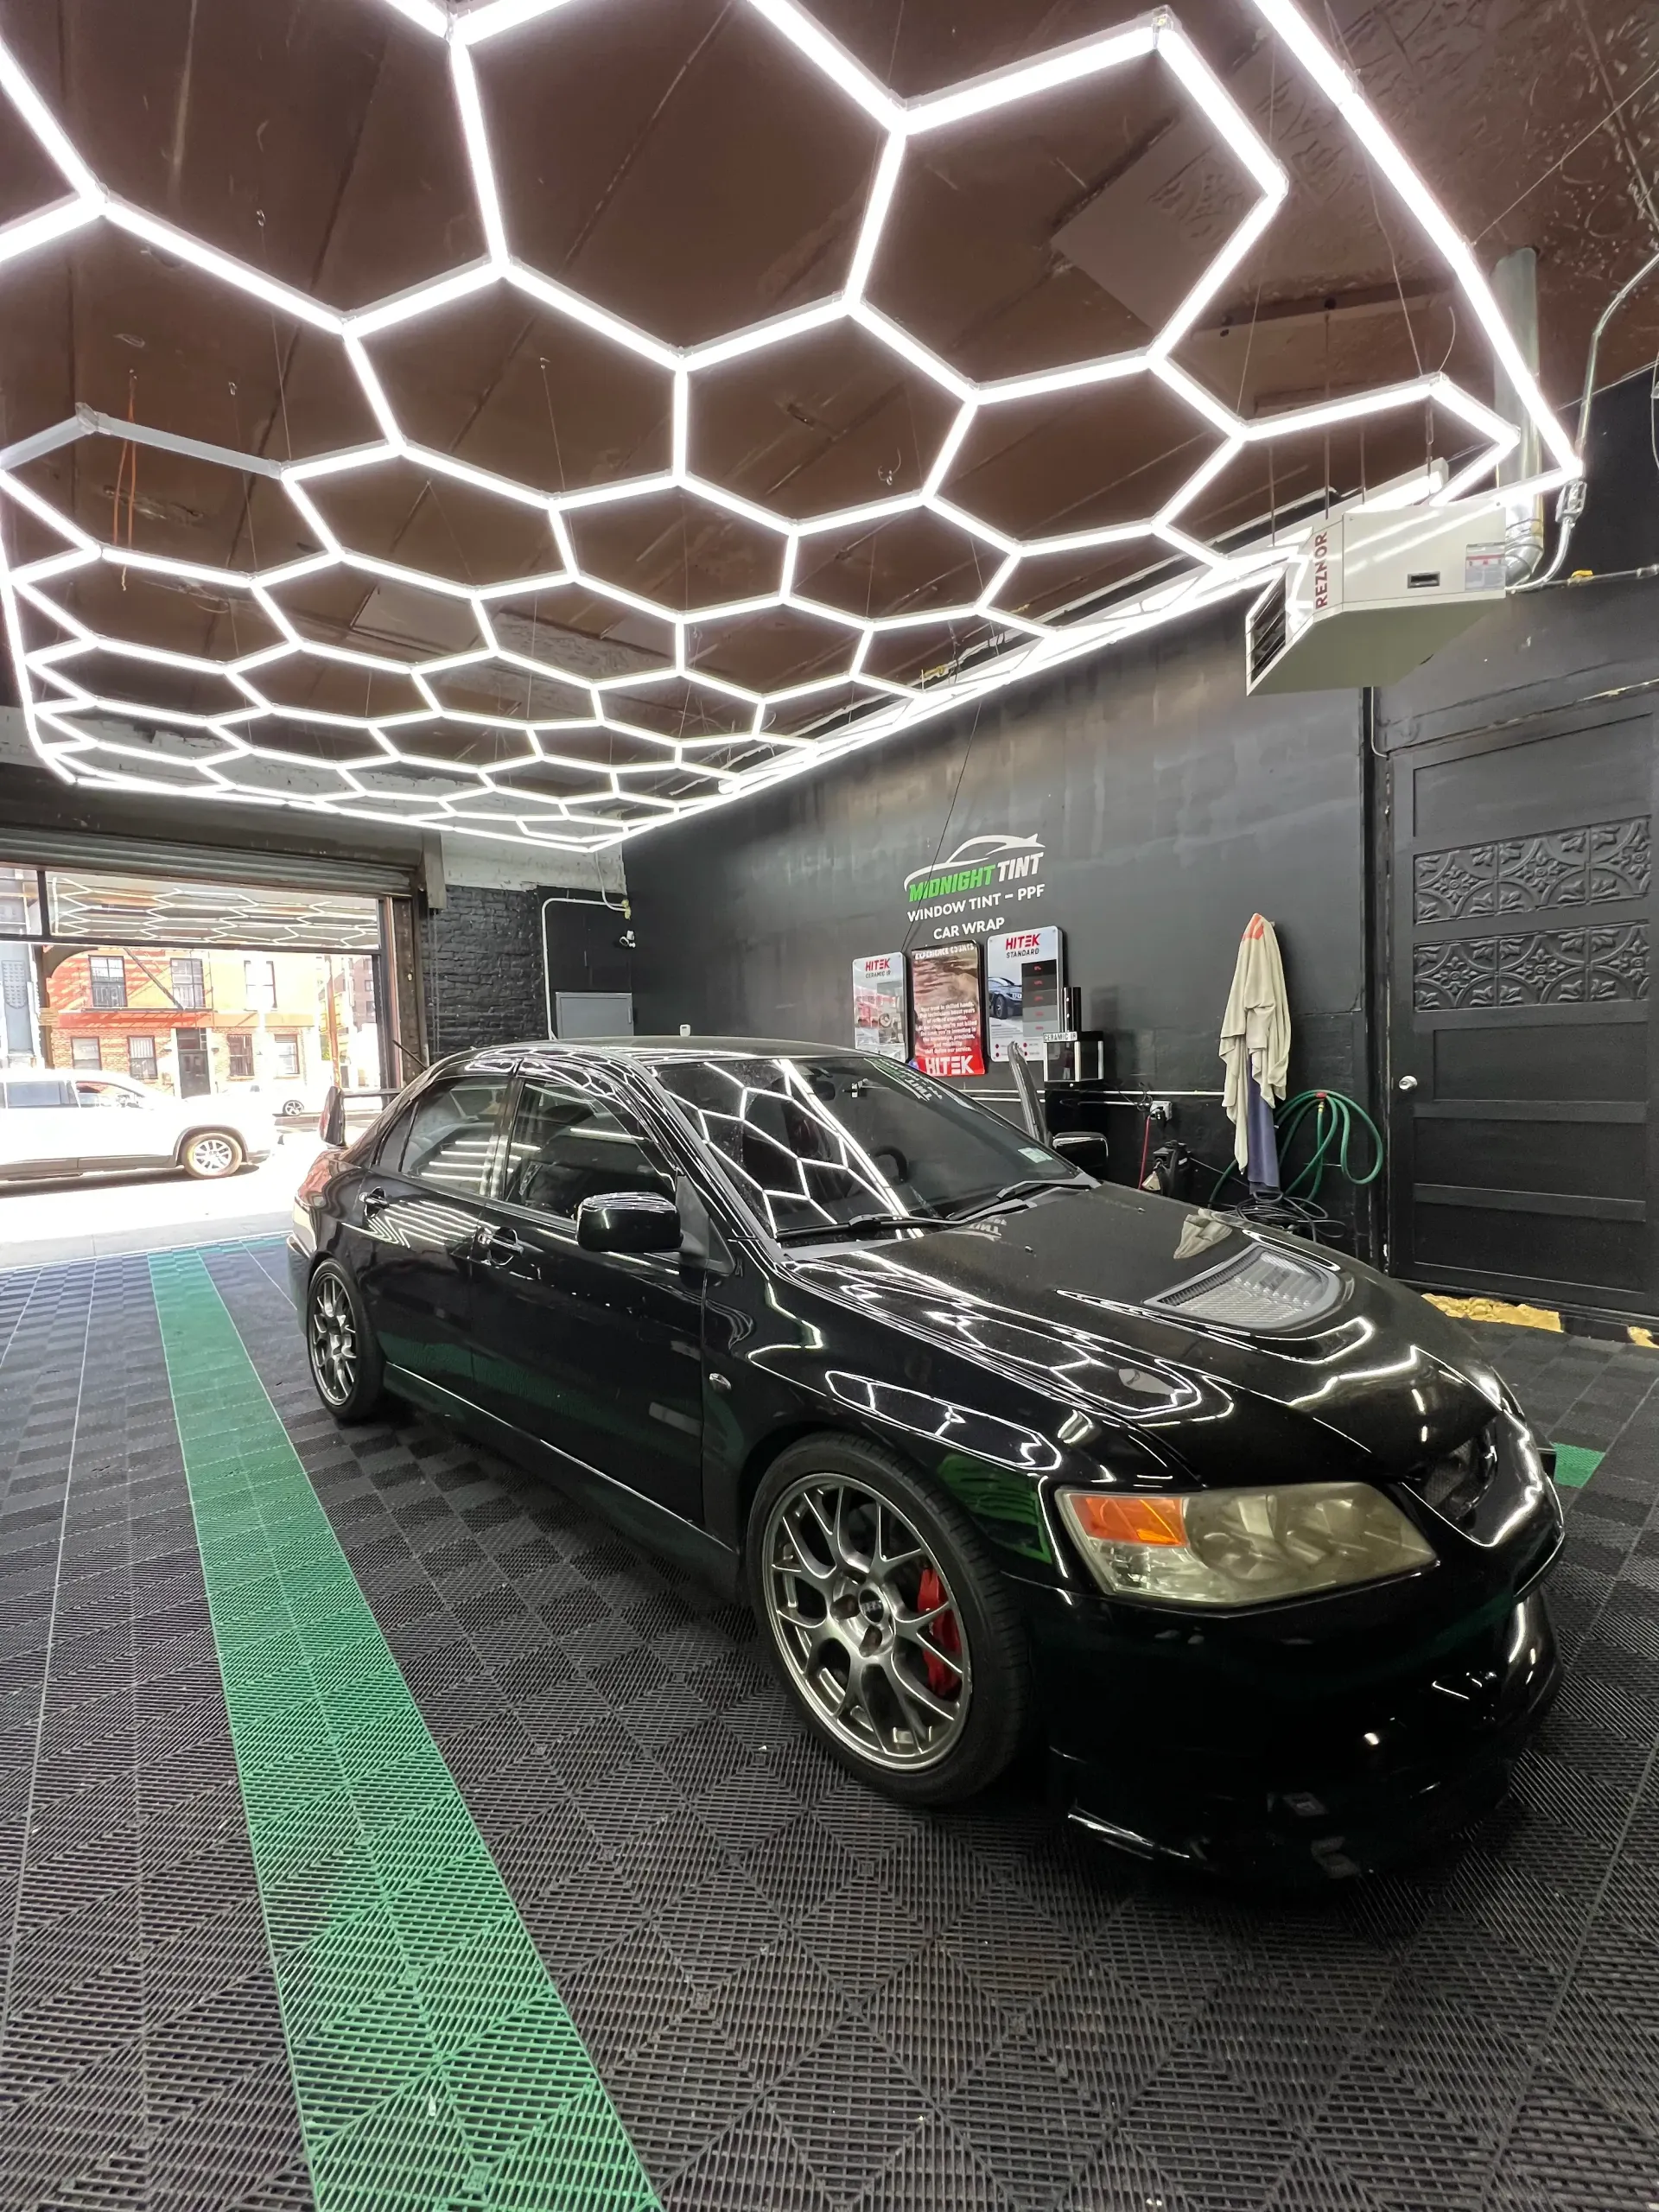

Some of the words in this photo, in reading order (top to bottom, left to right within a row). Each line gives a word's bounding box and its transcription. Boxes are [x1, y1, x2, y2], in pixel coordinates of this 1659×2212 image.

[1315, 531, 1328, 609] REZNOR
[908, 864, 995, 902] MIDNIGHT
[997, 852, 1044, 882] TINT
[907, 899, 966, 922] WINDOW
[969, 893, 1002, 912] TINT
[1017, 884, 1046, 901] PPF
[933, 925, 959, 940] CAR
[961, 917, 1005, 936] WRAP
[1005, 933, 1041, 950] HITEK
[915, 947, 949, 960] EXPERIENCE
[950, 943, 975, 954] COUNTS
[1006, 947, 1039, 959] STANDARD
[865, 958, 891, 972] HITEK
[1043, 1033, 1068, 1042] CERAMIC
[925, 1055, 974, 1075] HITEK
